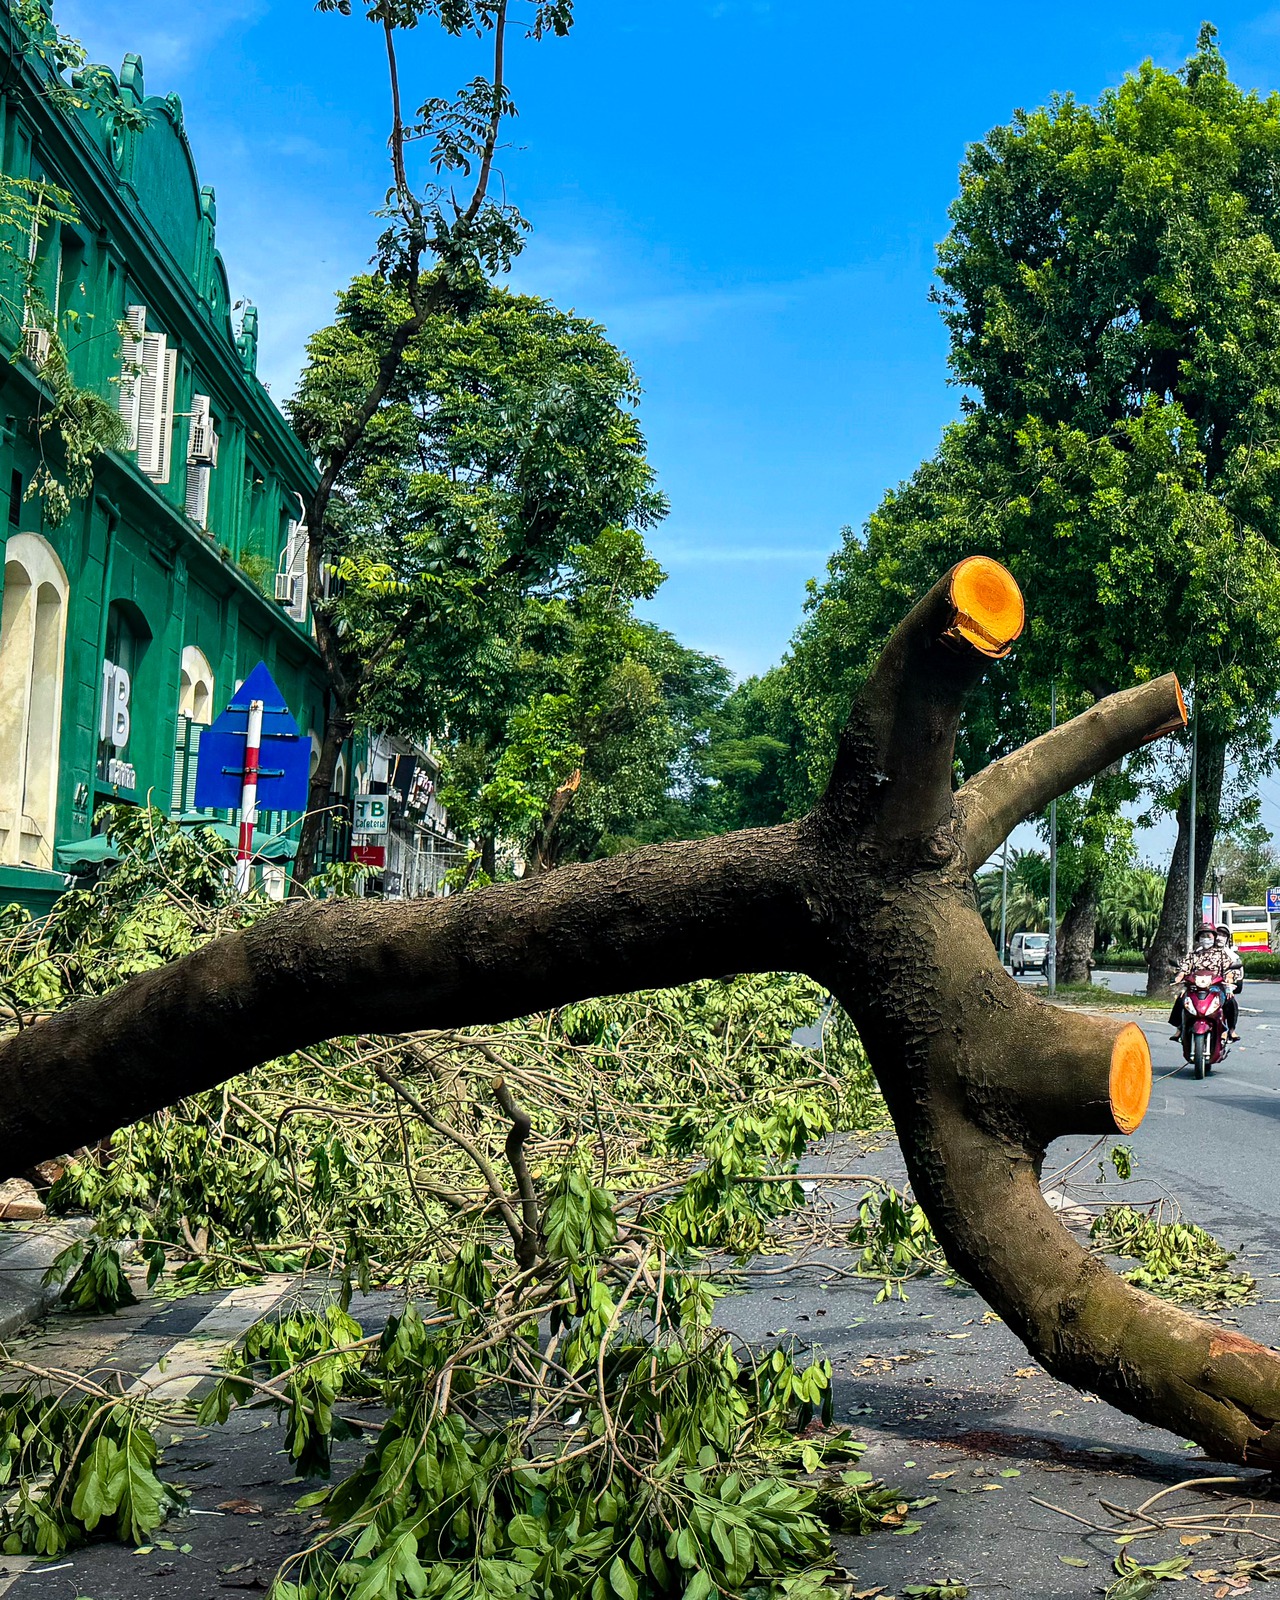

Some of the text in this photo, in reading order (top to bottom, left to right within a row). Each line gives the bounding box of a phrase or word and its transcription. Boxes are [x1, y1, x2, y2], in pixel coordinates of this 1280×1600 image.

[101, 658, 130, 748] TB
[356, 801, 385, 817] TB
[356, 819, 386, 828] Cafeteria
